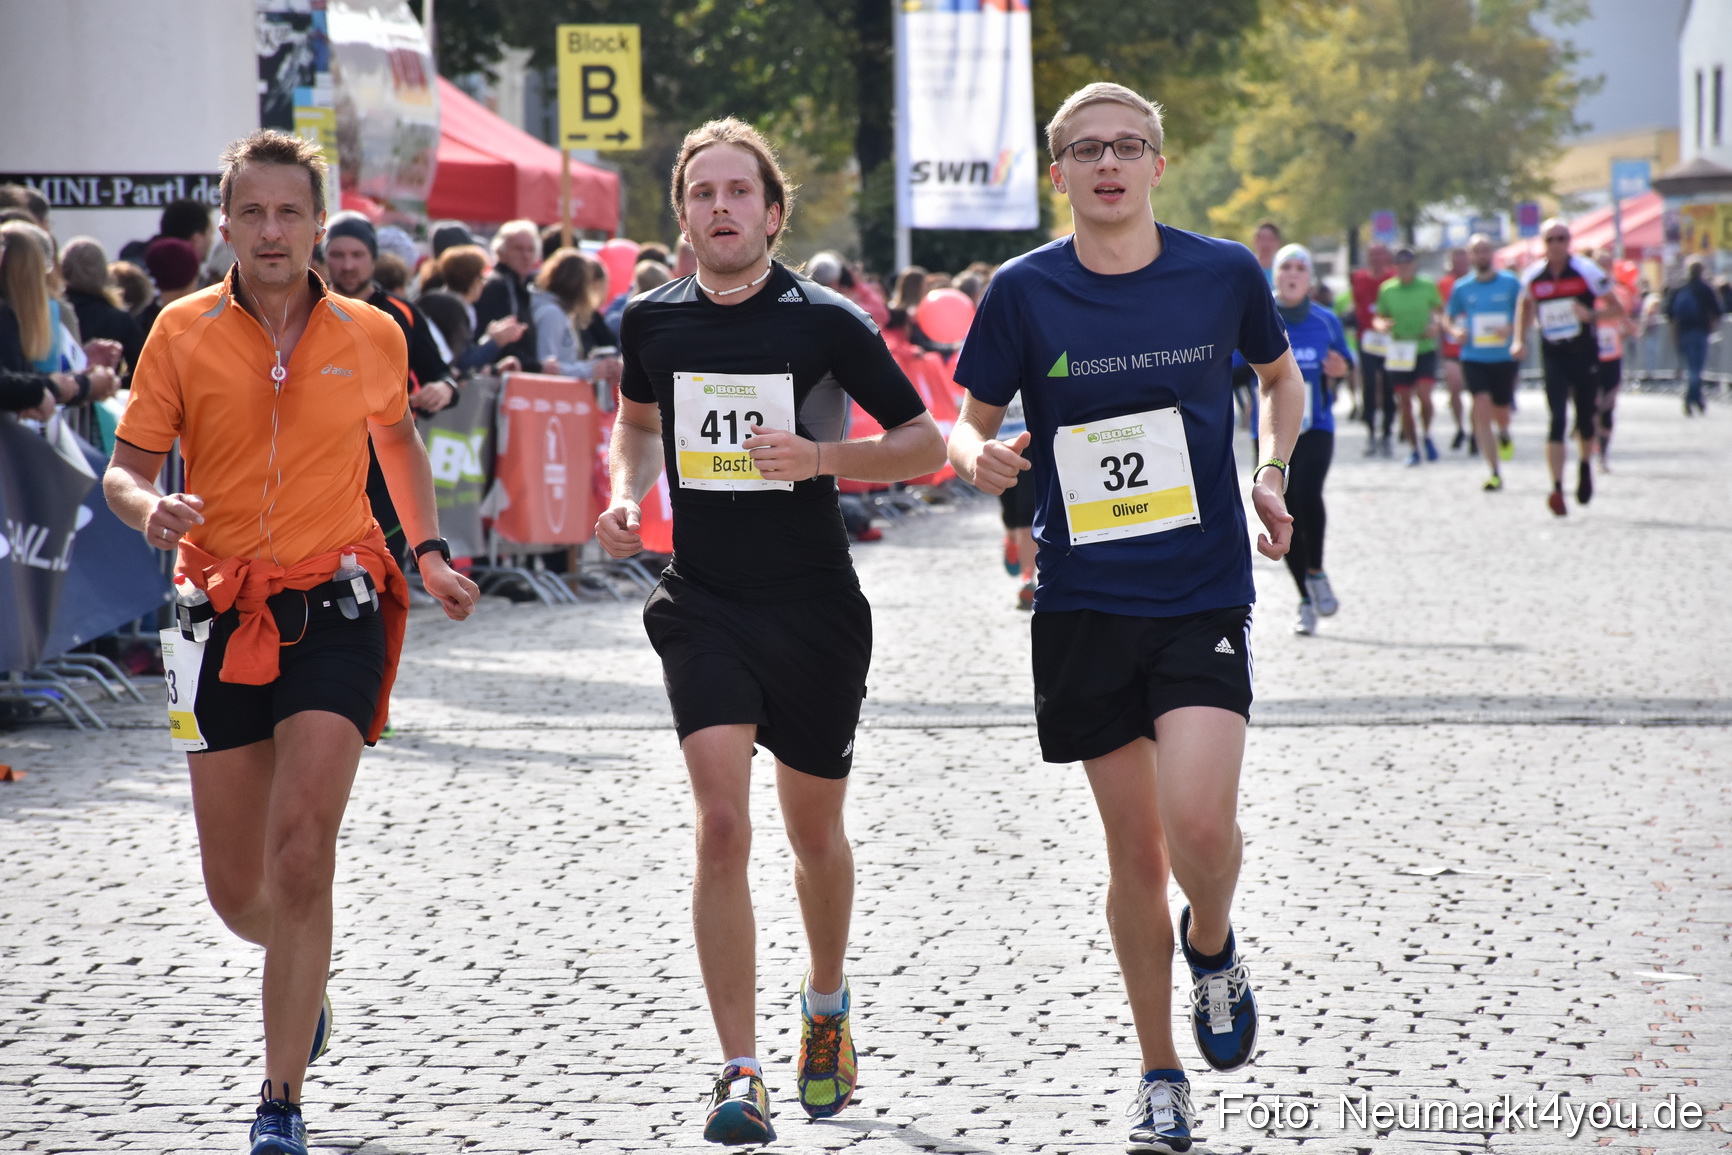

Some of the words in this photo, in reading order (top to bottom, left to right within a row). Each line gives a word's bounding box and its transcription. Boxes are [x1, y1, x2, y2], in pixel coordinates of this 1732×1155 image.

[568, 32, 630, 54] Block
[581, 65, 620, 121] B
[909, 160, 990, 185] swn
[1070, 356, 1128, 377] GOSSEN
[1131, 344, 1215, 370] METRAWATT
[332, 368, 353, 377] asics
[716, 385, 757, 396] BOCK
[1100, 424, 1146, 441] BOCK
[713, 455, 753, 473] Basti
[1100, 452, 1149, 492] 32
[1112, 502, 1150, 518] Oliver
